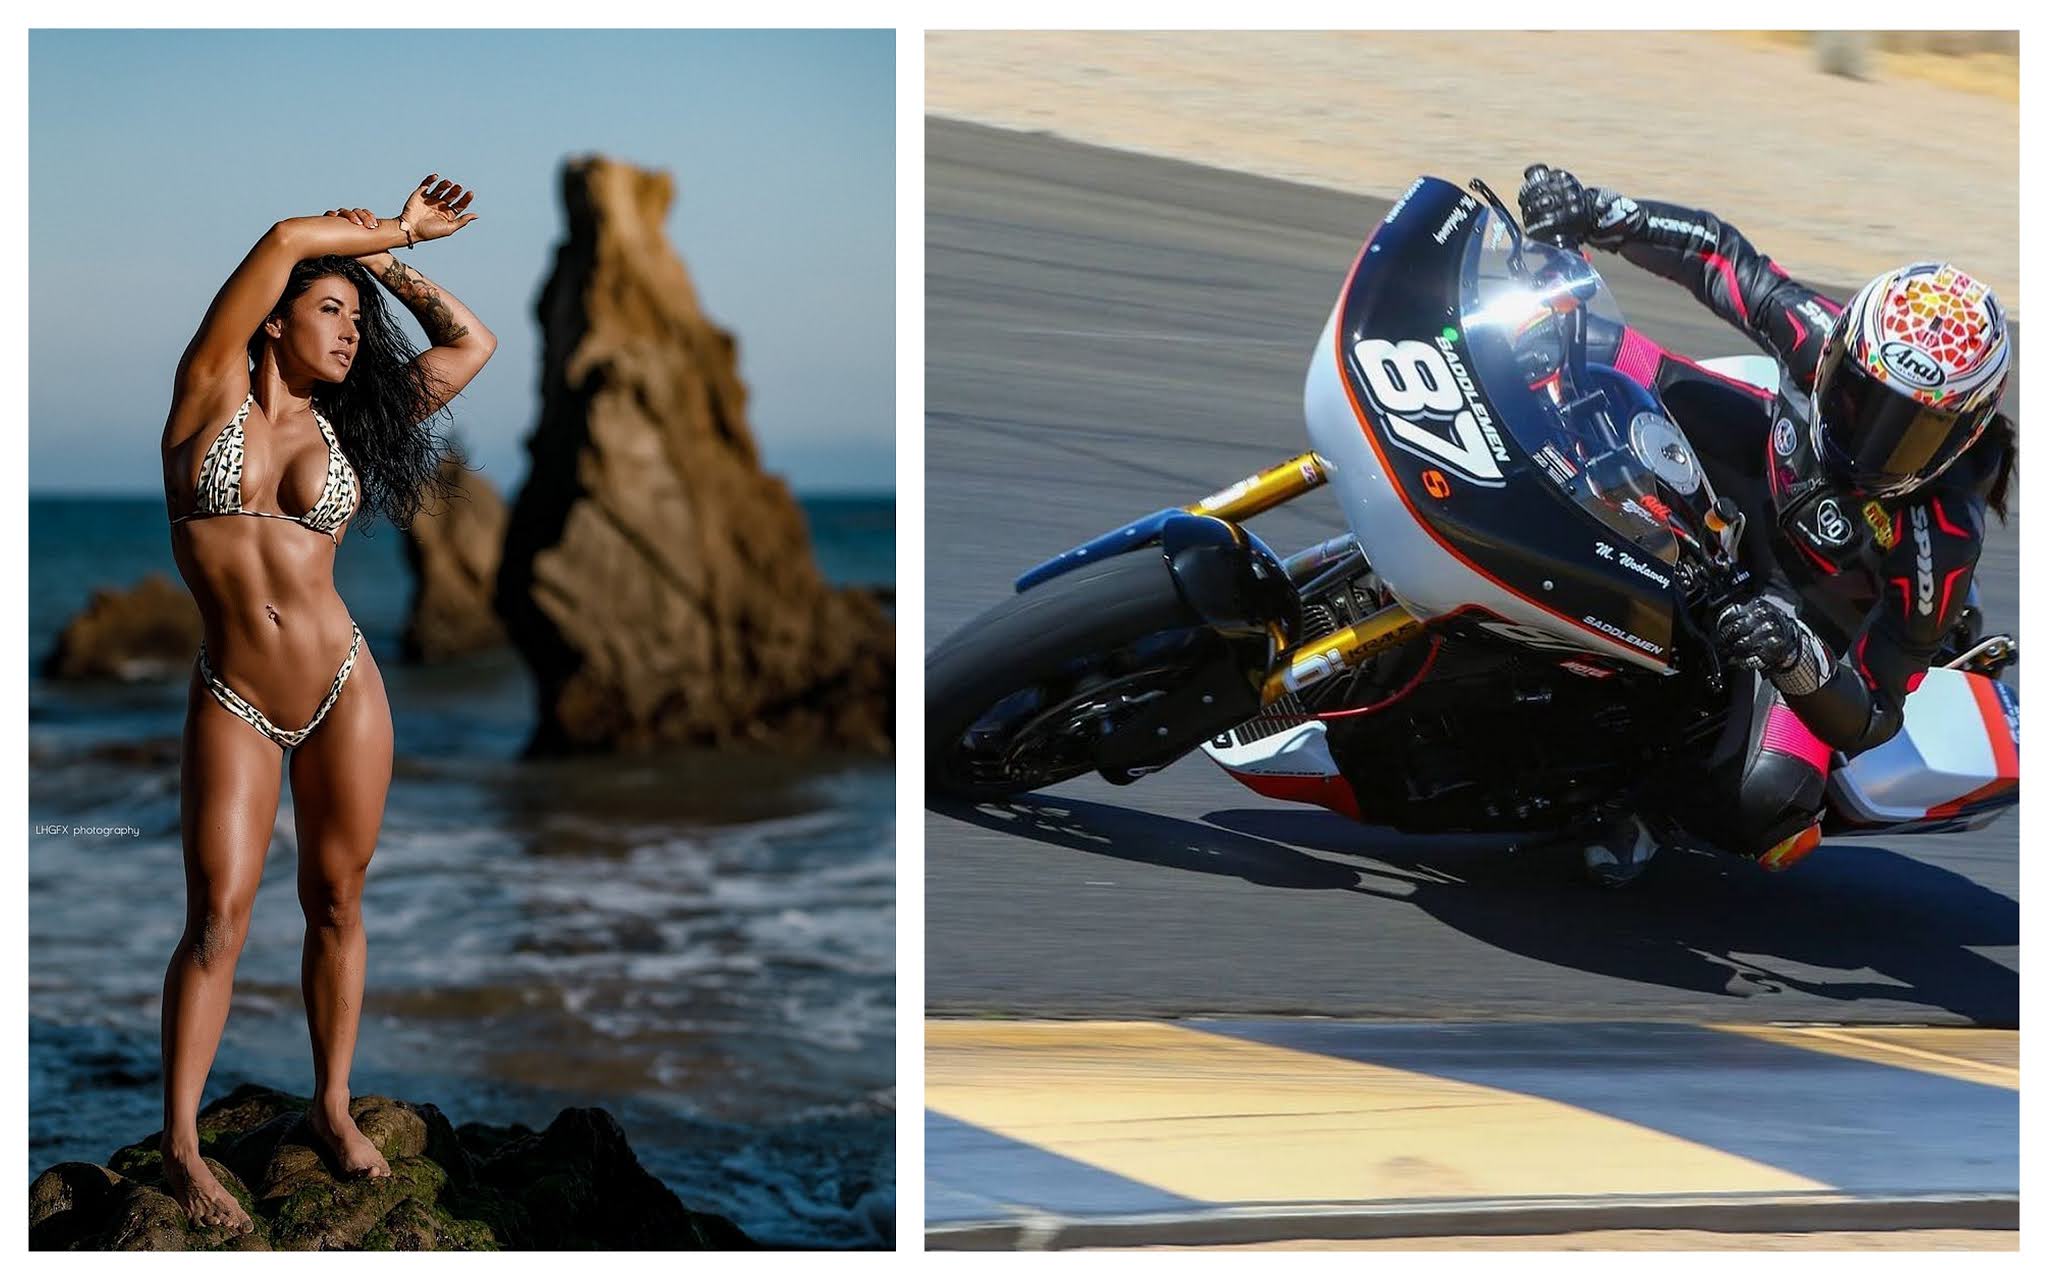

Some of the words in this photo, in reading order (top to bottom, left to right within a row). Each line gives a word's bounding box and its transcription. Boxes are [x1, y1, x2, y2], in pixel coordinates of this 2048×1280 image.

[1883, 348, 1940, 381] Arai
[1350, 339, 1507, 488] 87
[1434, 336, 1511, 463] SADDLEMEN
[1595, 541, 1614, 560] M.
[1619, 552, 1671, 589] Woolaway
[1582, 615, 1664, 655] SADDLEMEN
